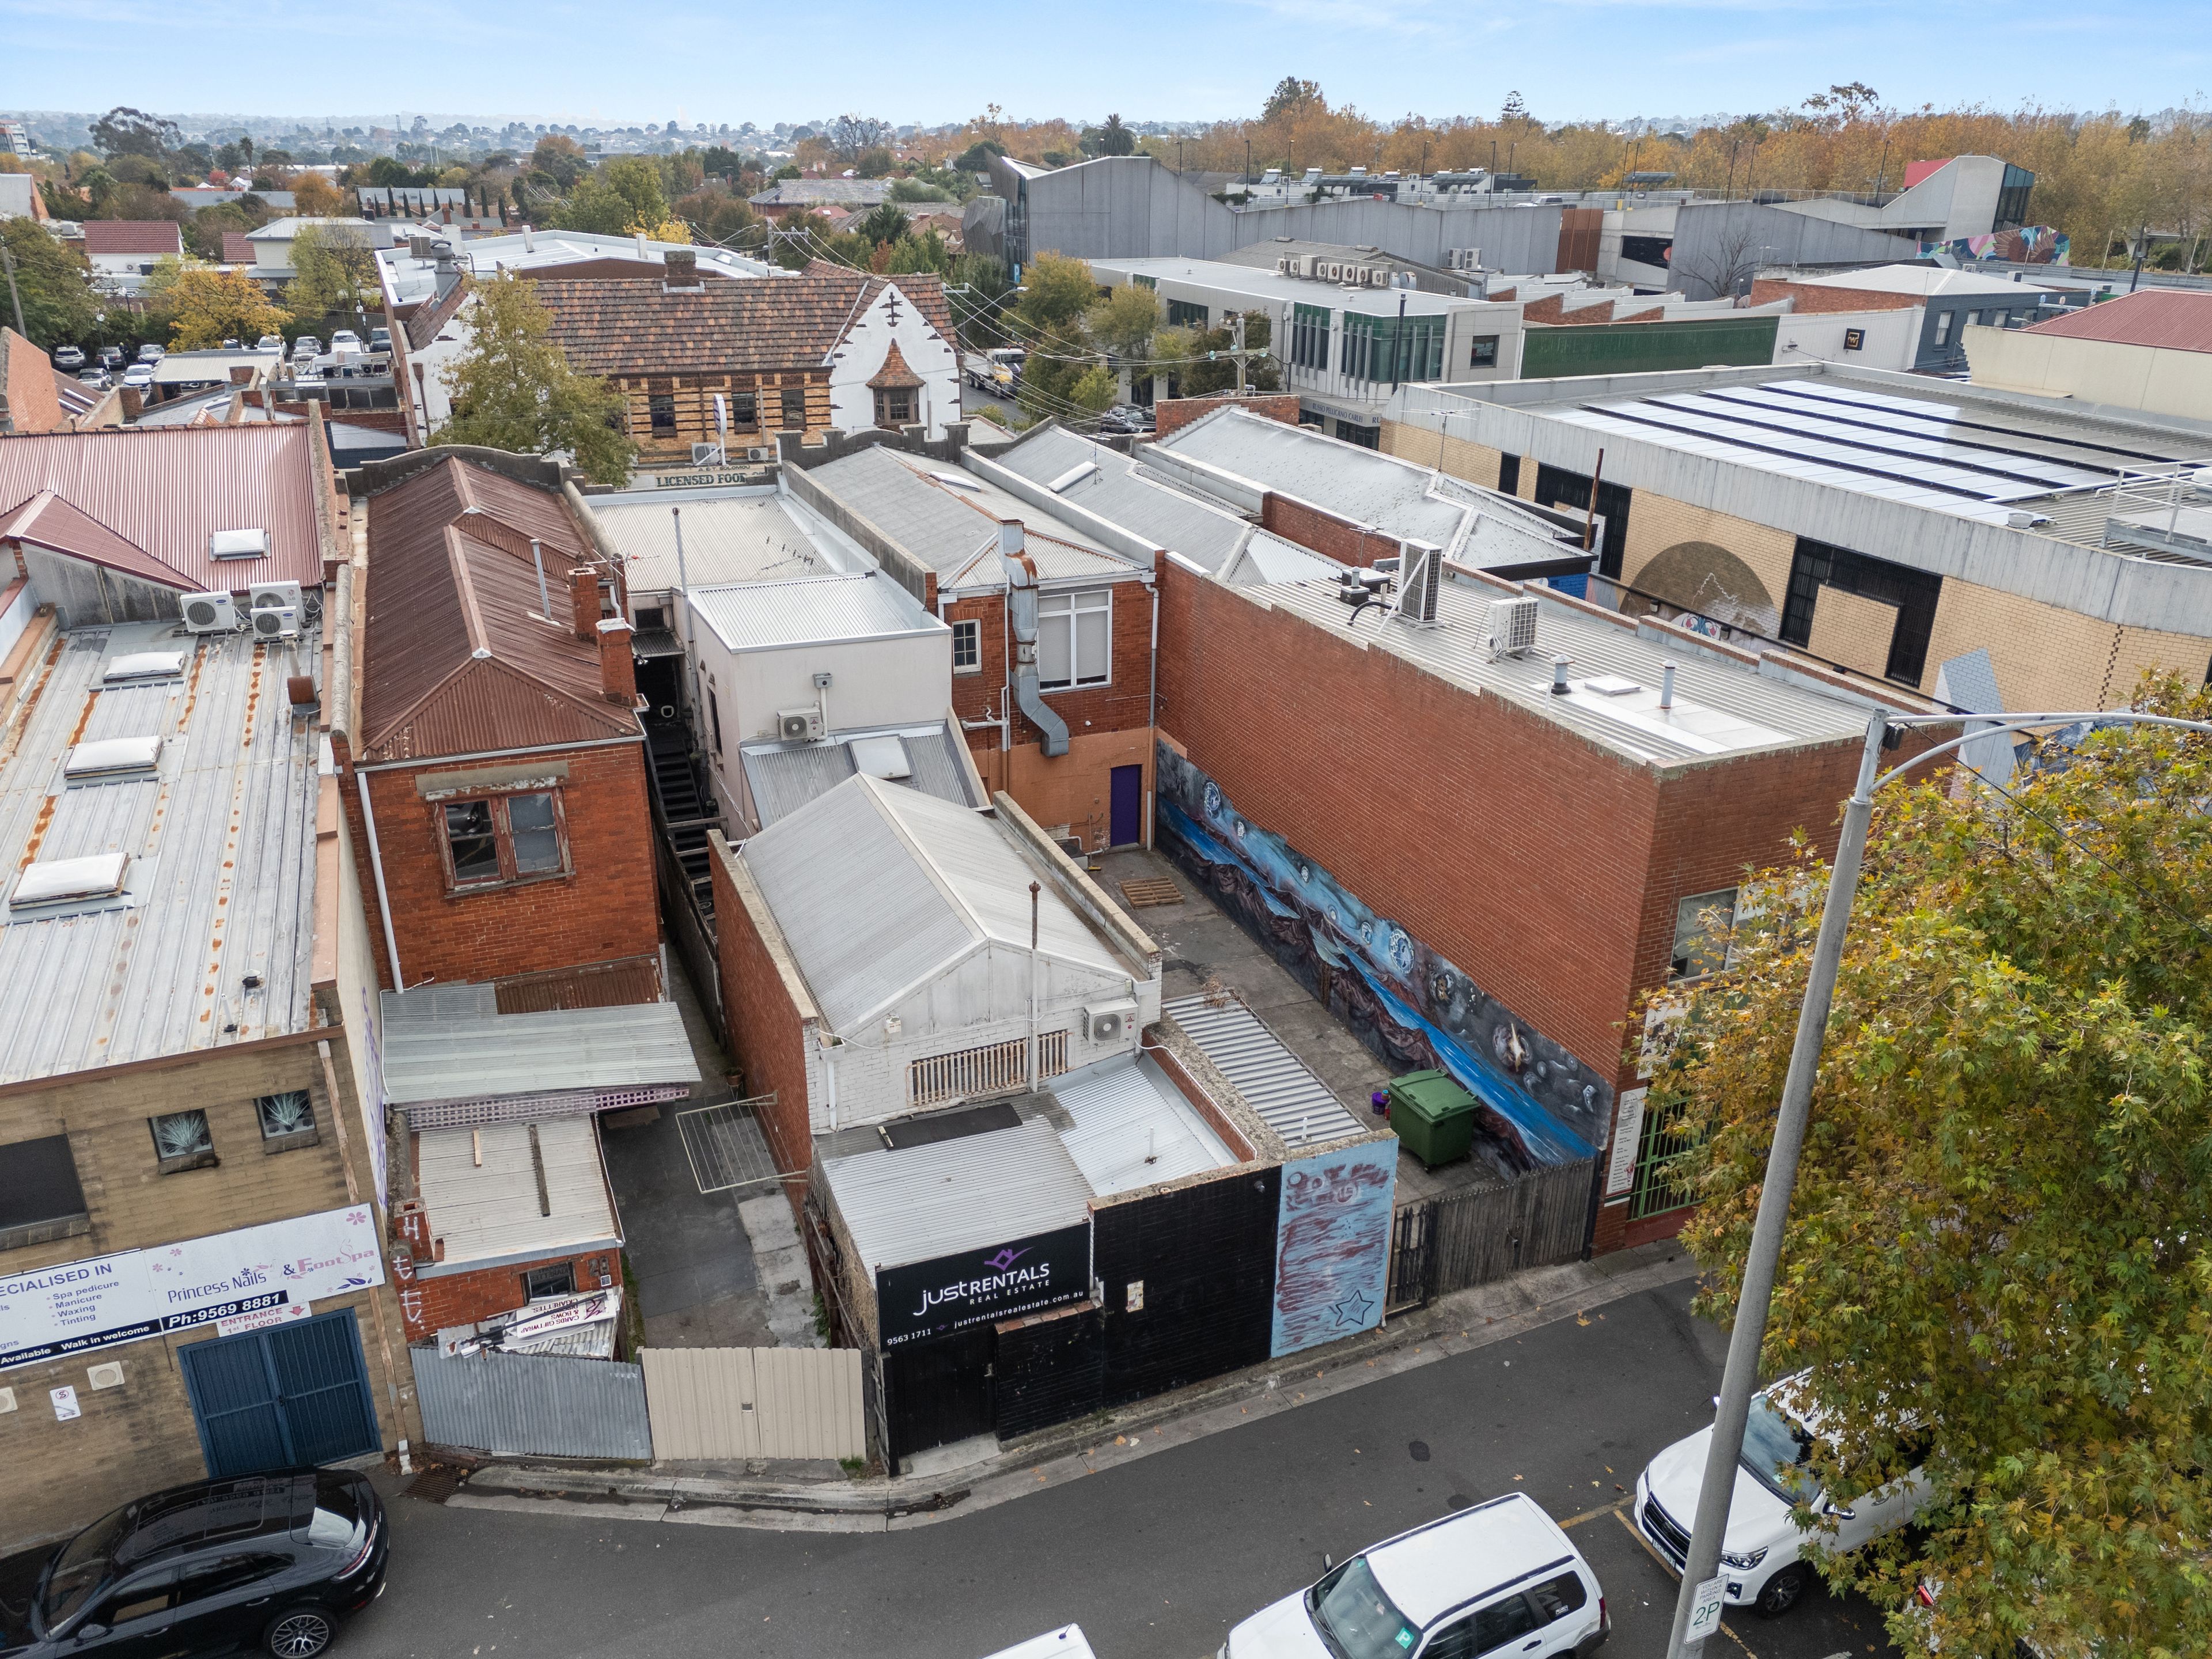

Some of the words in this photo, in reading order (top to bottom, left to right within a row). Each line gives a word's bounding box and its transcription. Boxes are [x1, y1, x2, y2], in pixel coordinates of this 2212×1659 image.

[1014, 264, 1020, 282] P
[656, 475, 714, 487] LICENSED
[94, 1263, 112, 1276] IN
[53, 1291, 73, 1300] Spa
[75, 1281, 119, 1297] pedicure
[168, 1280, 229, 1303] Princess
[232, 1271, 267, 1290] Nails
[283, 1264, 296, 1275] &
[969, 1293, 998, 1305] REAL
[1007, 1279, 1050, 1296] ESTATE
[55, 1293, 103, 1309] Manicure
[954, 1290, 1084, 1329] justrentalsrealestate.com.au
[57, 1304, 96, 1318] Waxing
[60, 1313, 96, 1326] Tinting
[169, 1304, 237, 1328] Ph:9569
[241, 1293, 281, 1311] 8881
[221, 1308, 283, 1327] ENTRANCE
[551, 1310, 572, 1320] BOWS
[556, 1315, 579, 1324] CARDS
[245, 1317, 282, 1330] FLOOR
[1, 1348, 51, 1365] Available
[61, 1338, 89, 1350] Walk
[103, 1325, 150, 1340] welcome
[887, 1334, 908, 1346] 9563
[911, 1328, 931, 1340] 1711
[1693, 1601, 1720, 1626] 2P
[1398, 1632, 1411, 1642] P
